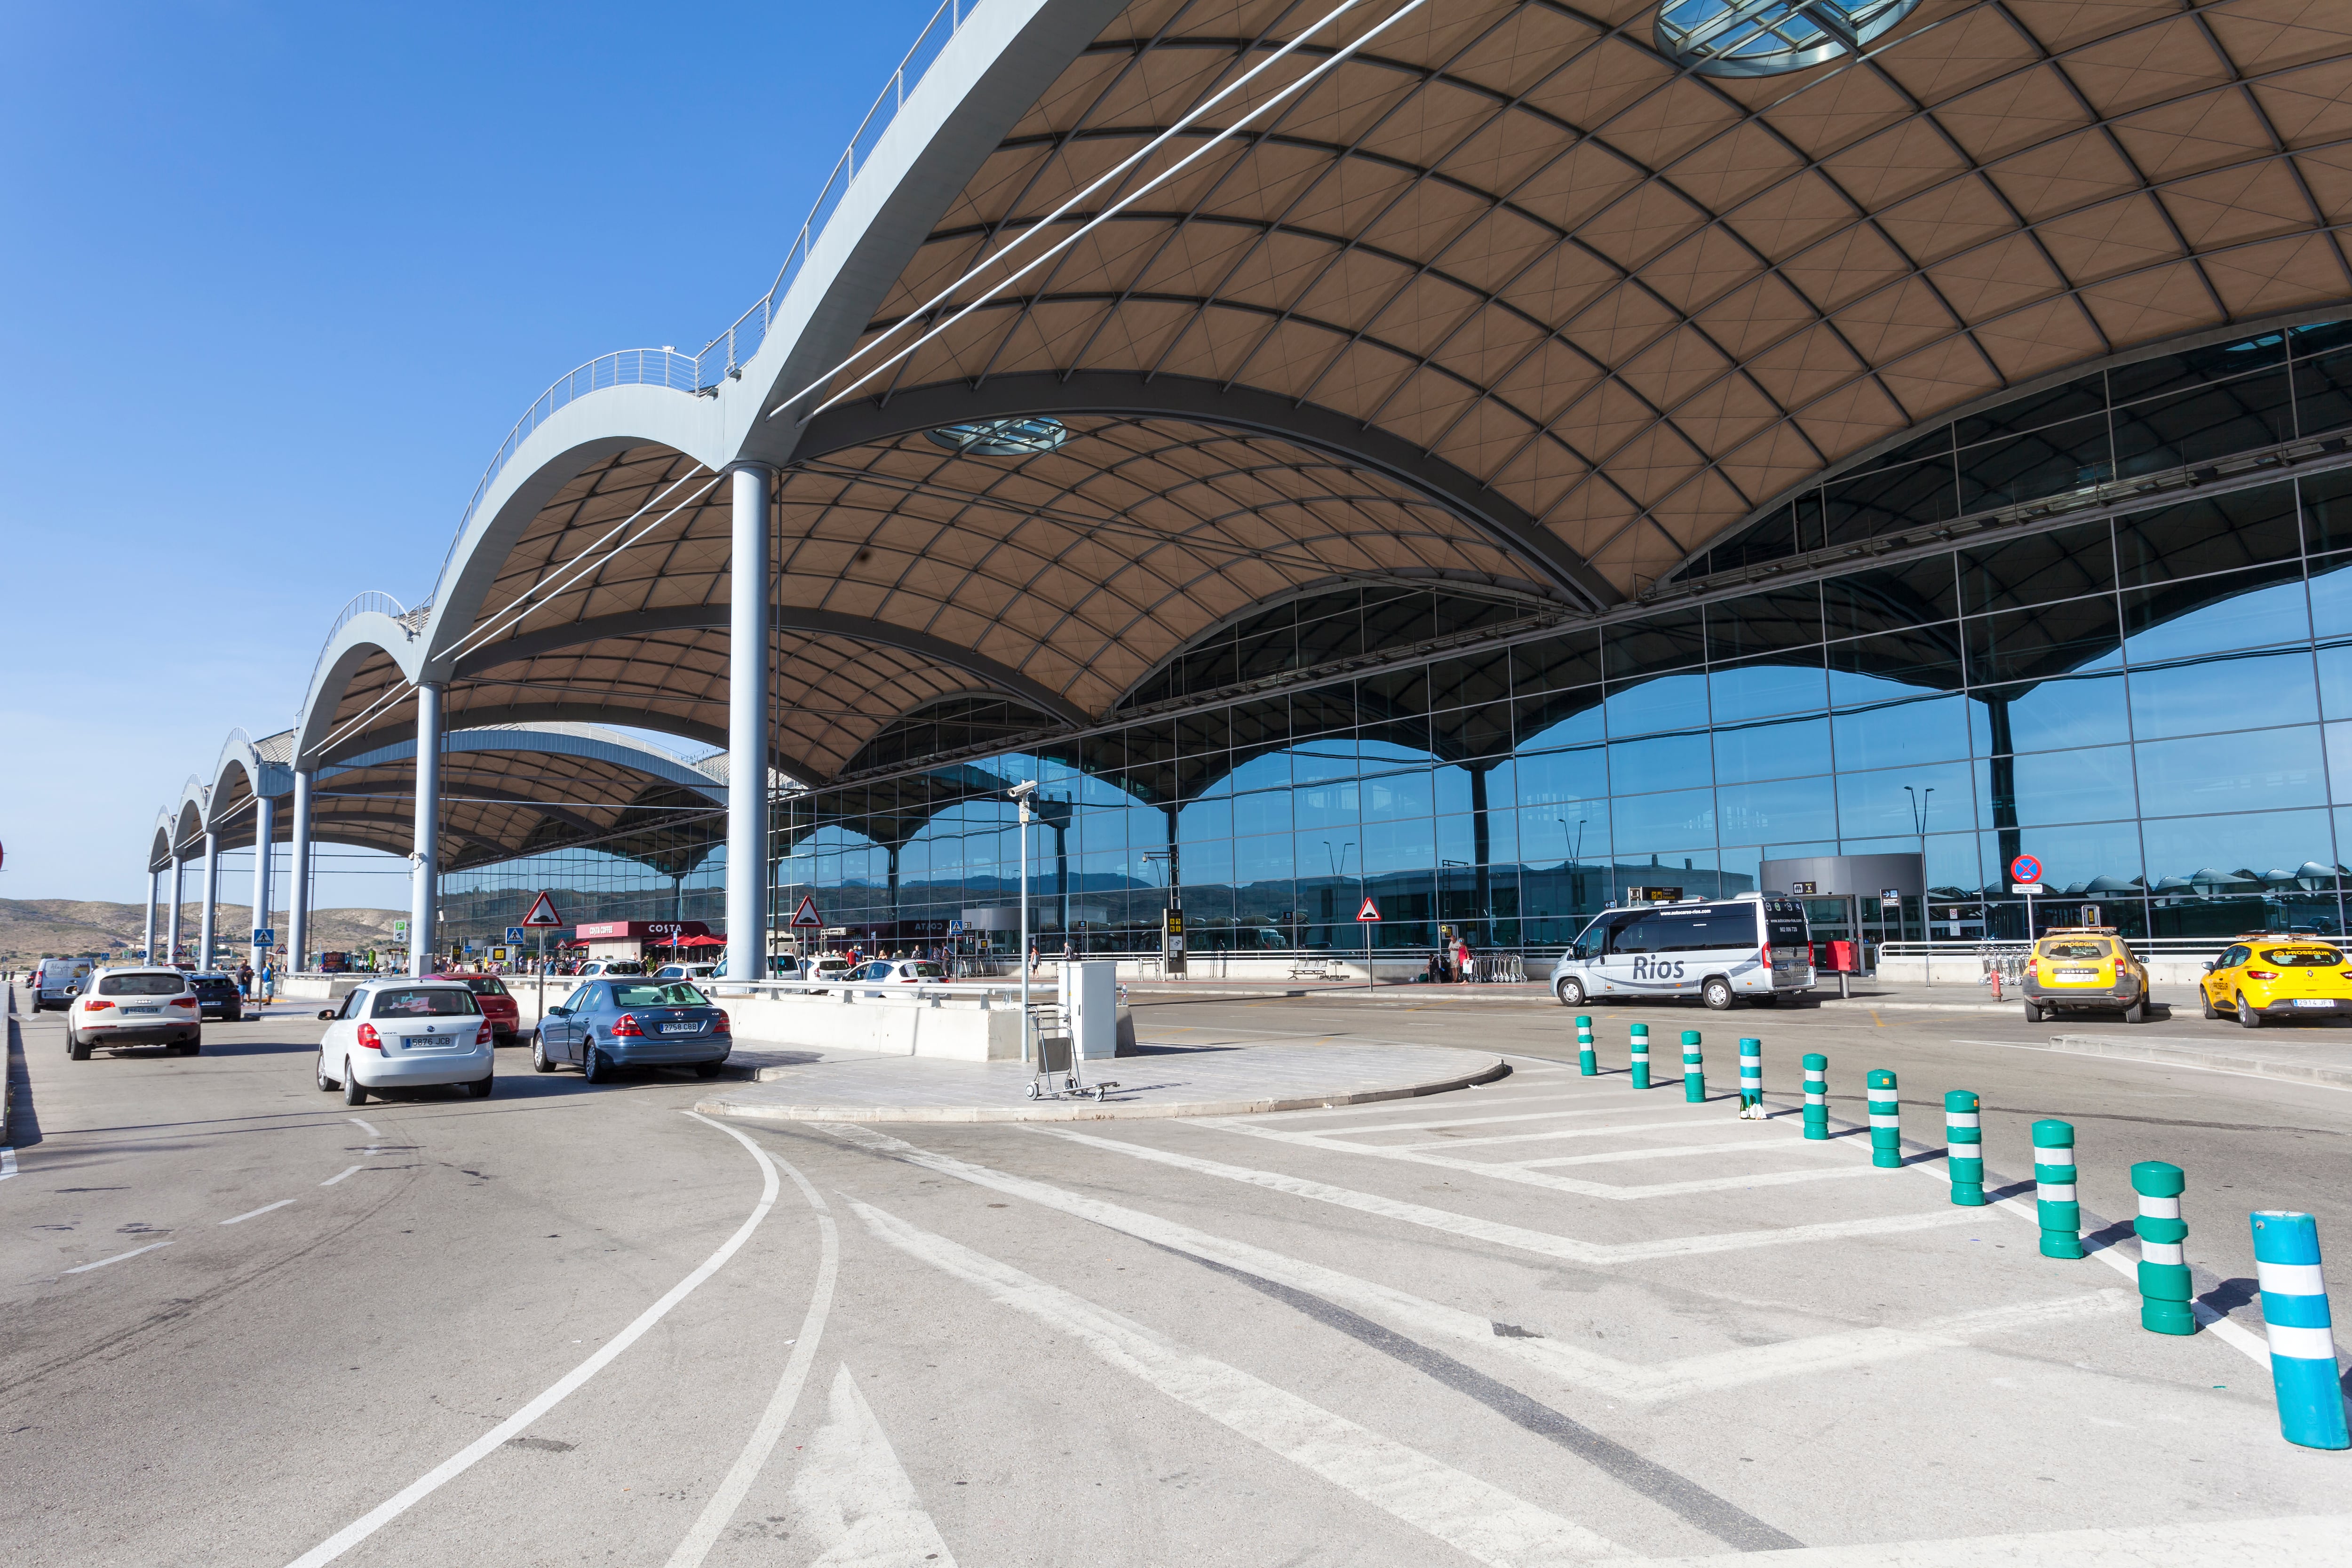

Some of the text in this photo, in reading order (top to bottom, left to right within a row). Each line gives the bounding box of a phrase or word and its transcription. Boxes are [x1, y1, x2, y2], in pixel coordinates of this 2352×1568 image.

[589, 925, 613, 935] COSTA COFFEE
[649, 924, 682, 932] COSTA
[1633, 954, 1684, 979] Rios
[1795, 961, 1808, 972] Rios
